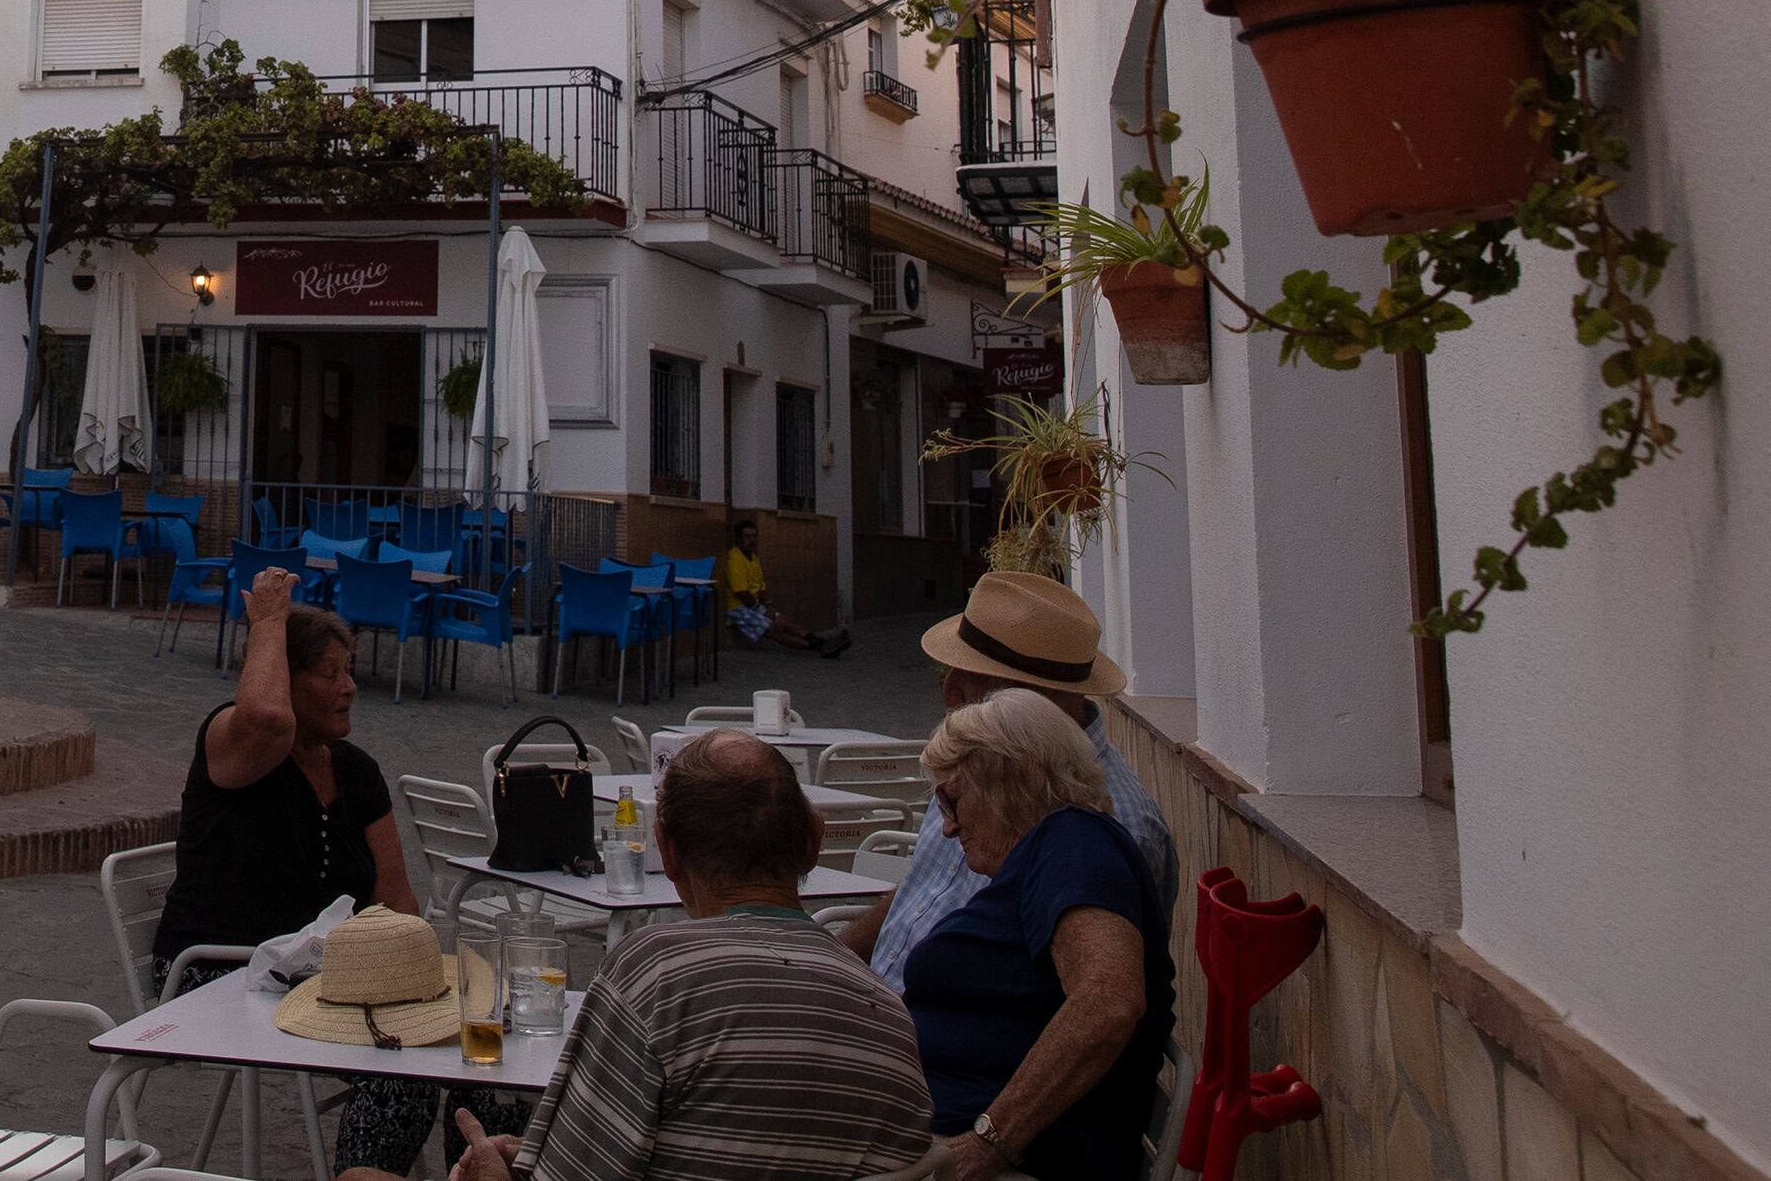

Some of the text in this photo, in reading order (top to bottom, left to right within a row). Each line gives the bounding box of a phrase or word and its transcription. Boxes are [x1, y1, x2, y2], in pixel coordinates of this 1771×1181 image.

[292, 261, 392, 300] Refugio
[992, 362, 1055, 387] Refugio
[861, 764, 897, 772] VICTORIA
